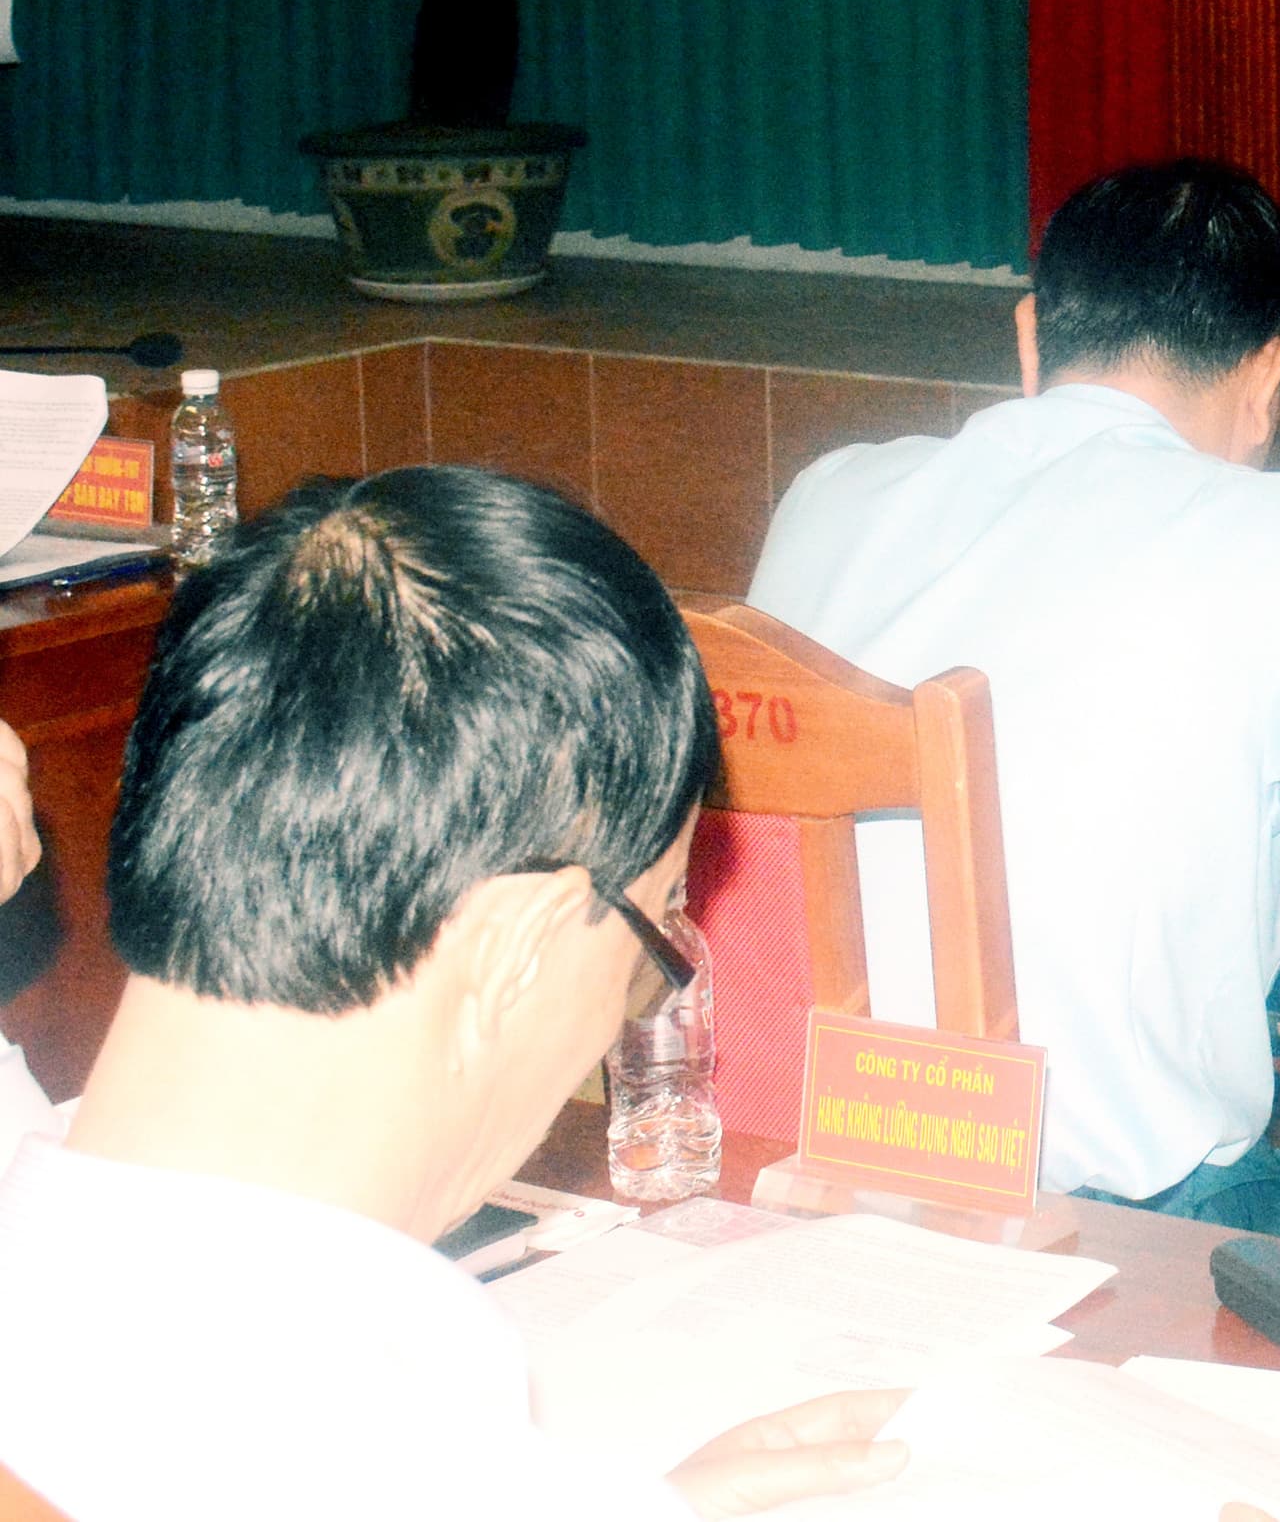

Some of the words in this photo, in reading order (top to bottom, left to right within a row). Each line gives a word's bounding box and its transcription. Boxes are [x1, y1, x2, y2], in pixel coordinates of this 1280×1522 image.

[855, 1047, 897, 1079] CÔNG
[902, 1059, 922, 1083] TY
[925, 1054, 948, 1087] CỔ
[952, 1063, 995, 1095] PHẦN
[816, 1085, 846, 1136] HÀNG
[846, 1092, 882, 1144] KHÔNG
[919, 1112, 949, 1161] DỤNG
[977, 1121, 998, 1164] SAO
[1000, 1118, 1025, 1175] VIỆT
